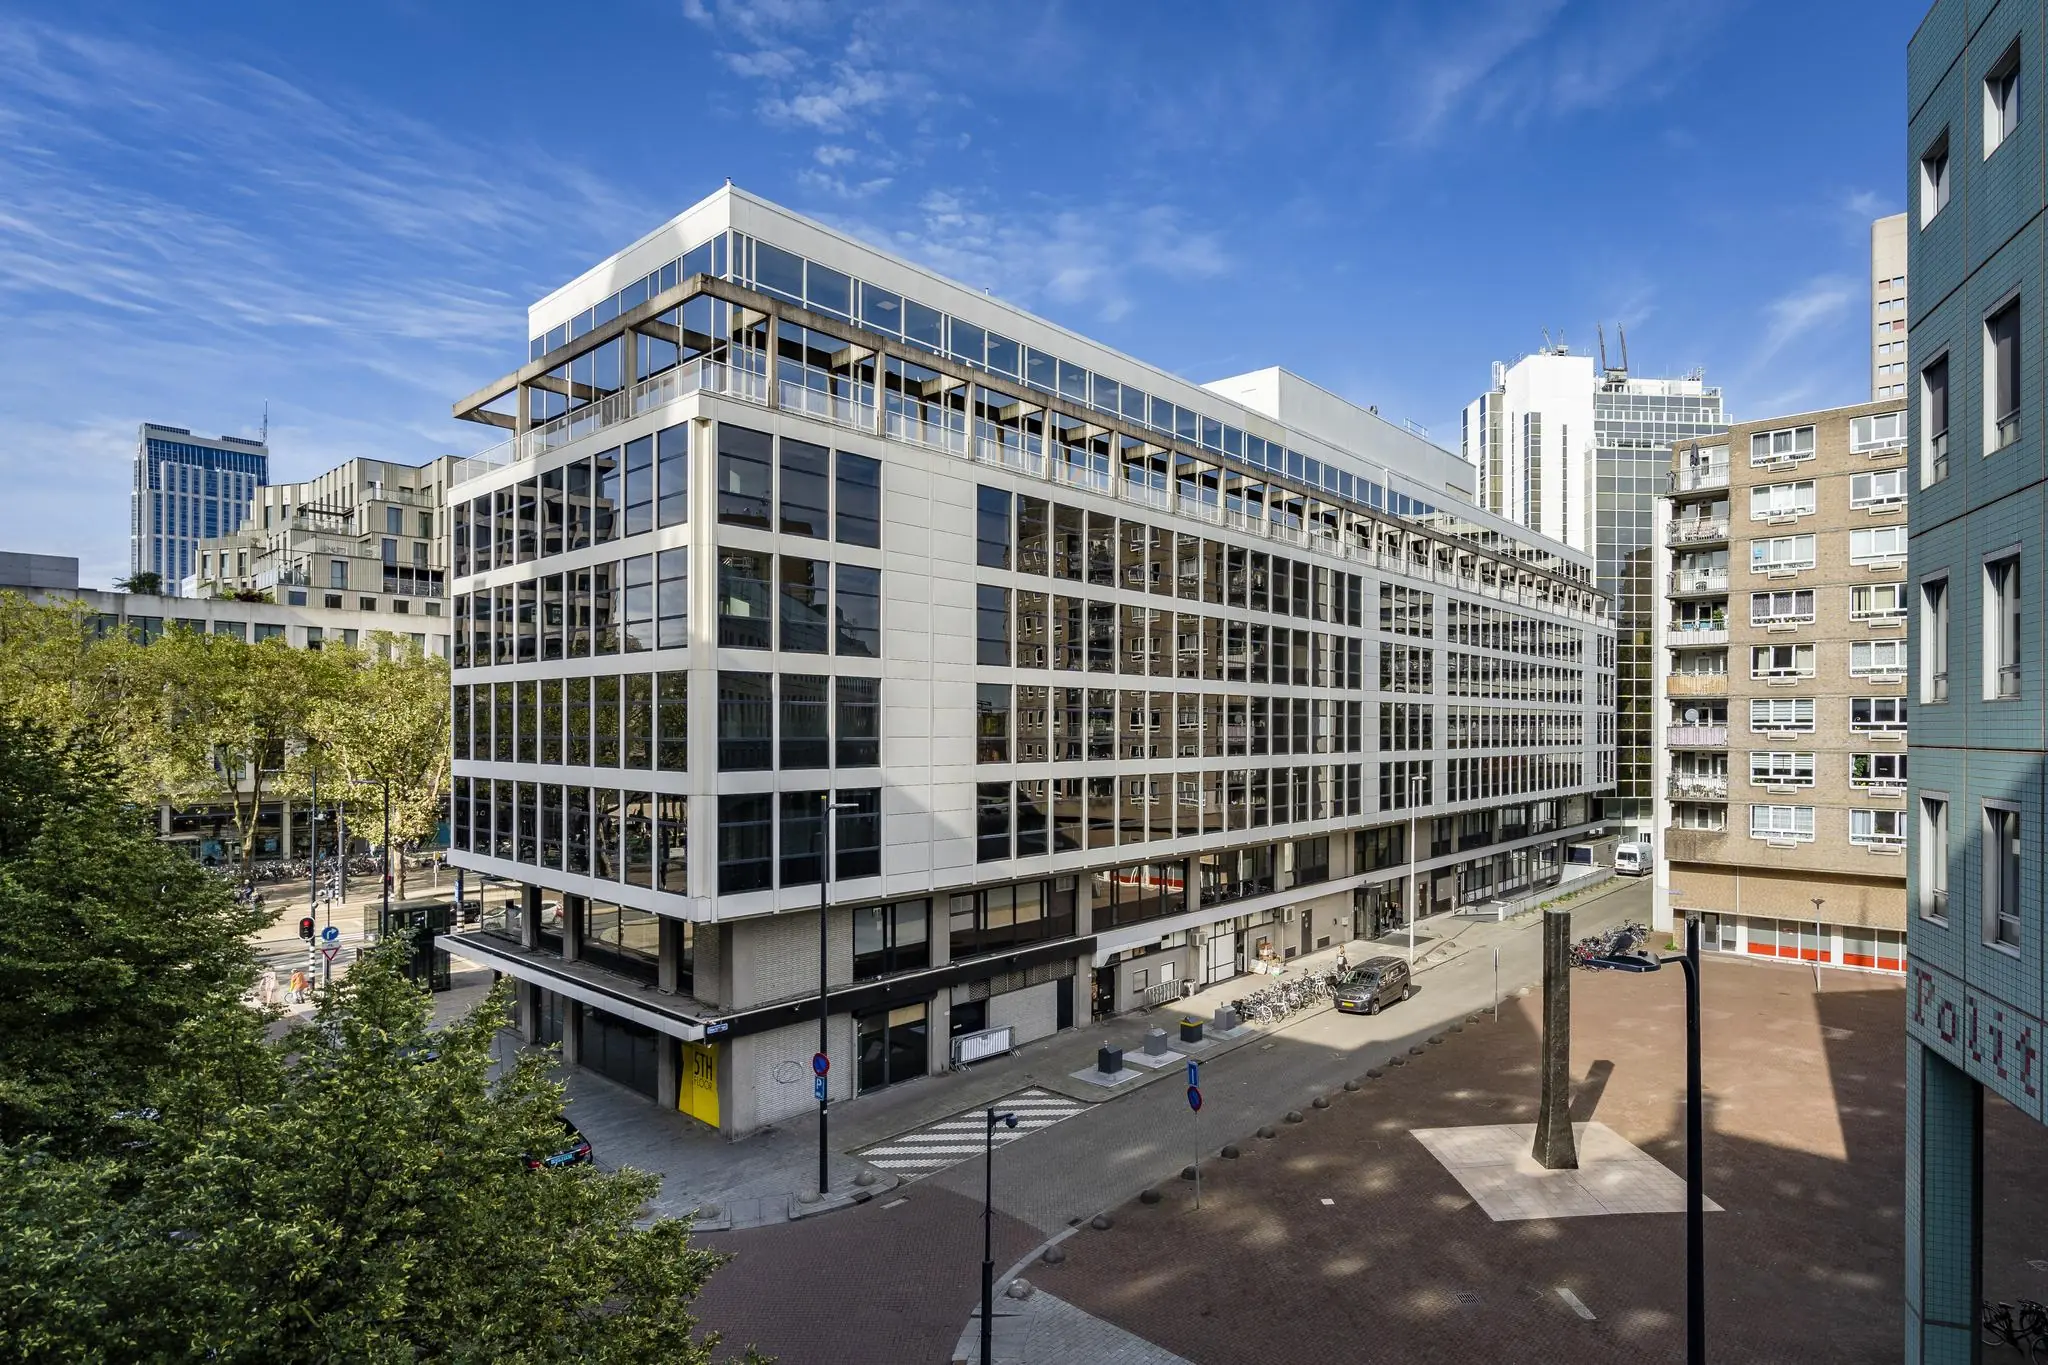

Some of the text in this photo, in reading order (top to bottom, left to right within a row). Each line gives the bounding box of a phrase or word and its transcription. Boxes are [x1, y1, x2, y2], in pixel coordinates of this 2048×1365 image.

[694, 1051, 713, 1081] 5TH
[693, 1075, 713, 1090] FLOOR
[816, 1078, 823, 1090] P
